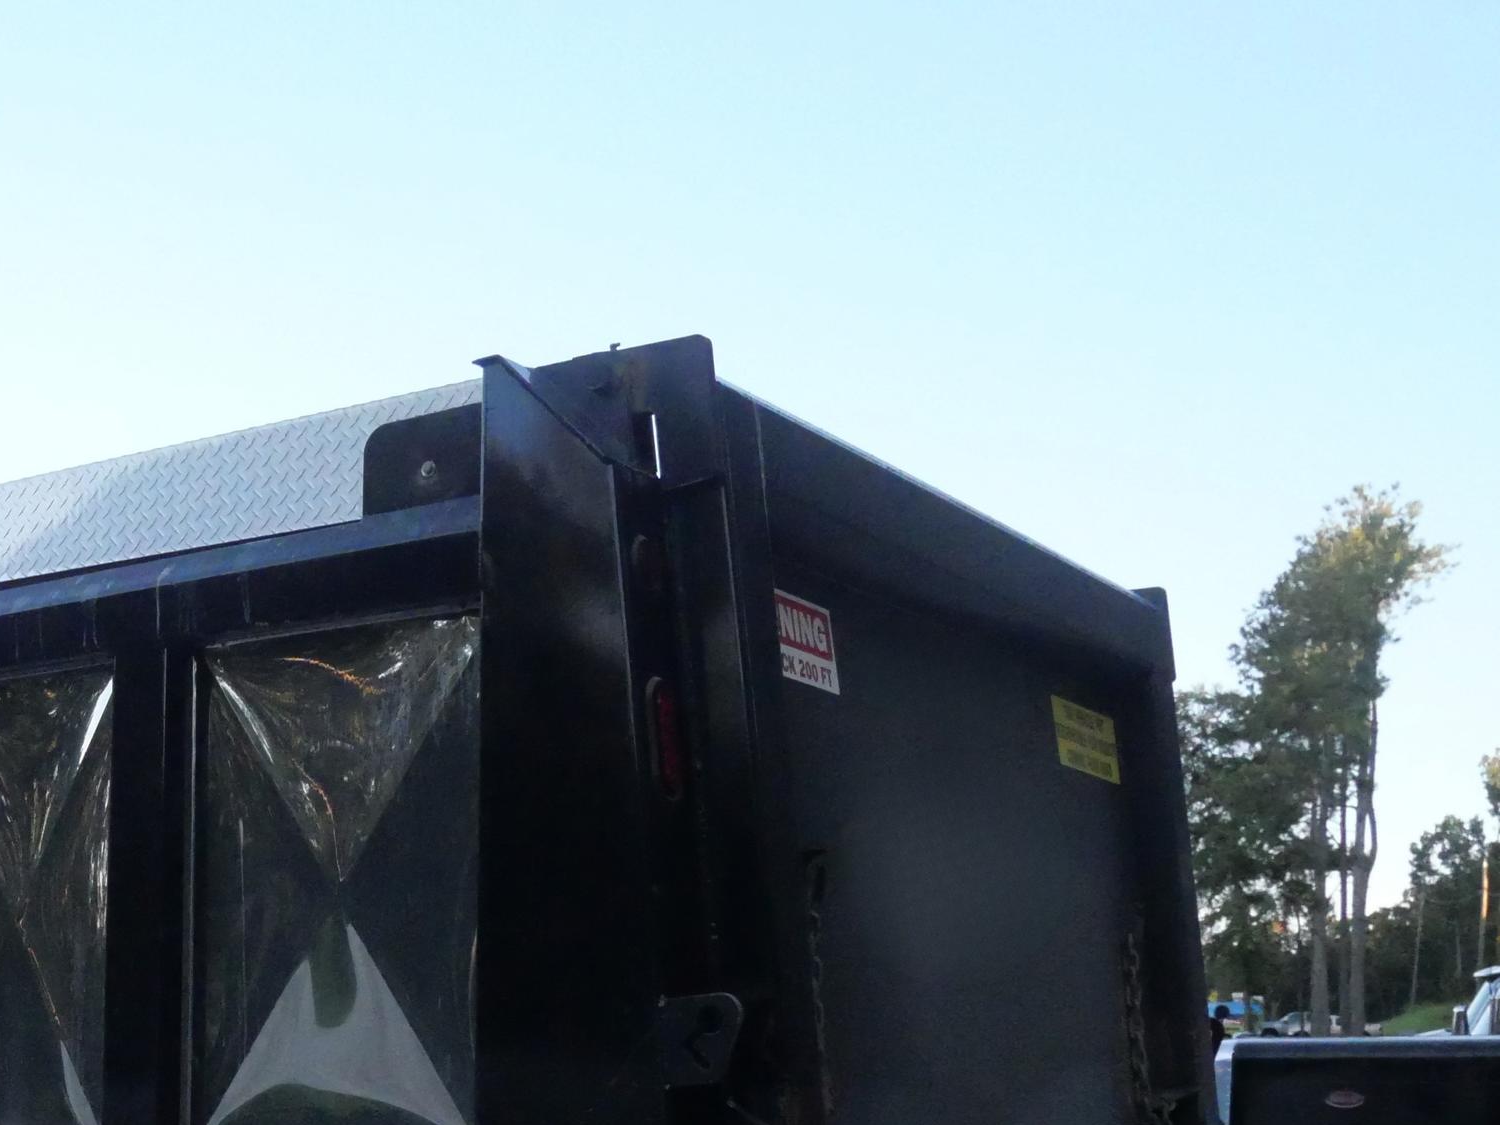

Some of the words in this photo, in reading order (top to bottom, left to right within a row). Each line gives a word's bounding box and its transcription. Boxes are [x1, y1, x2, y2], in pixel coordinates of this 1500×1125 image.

[778, 603, 828, 653] NING
[799, 658, 819, 683] 200
[820, 666, 833, 688] FT
